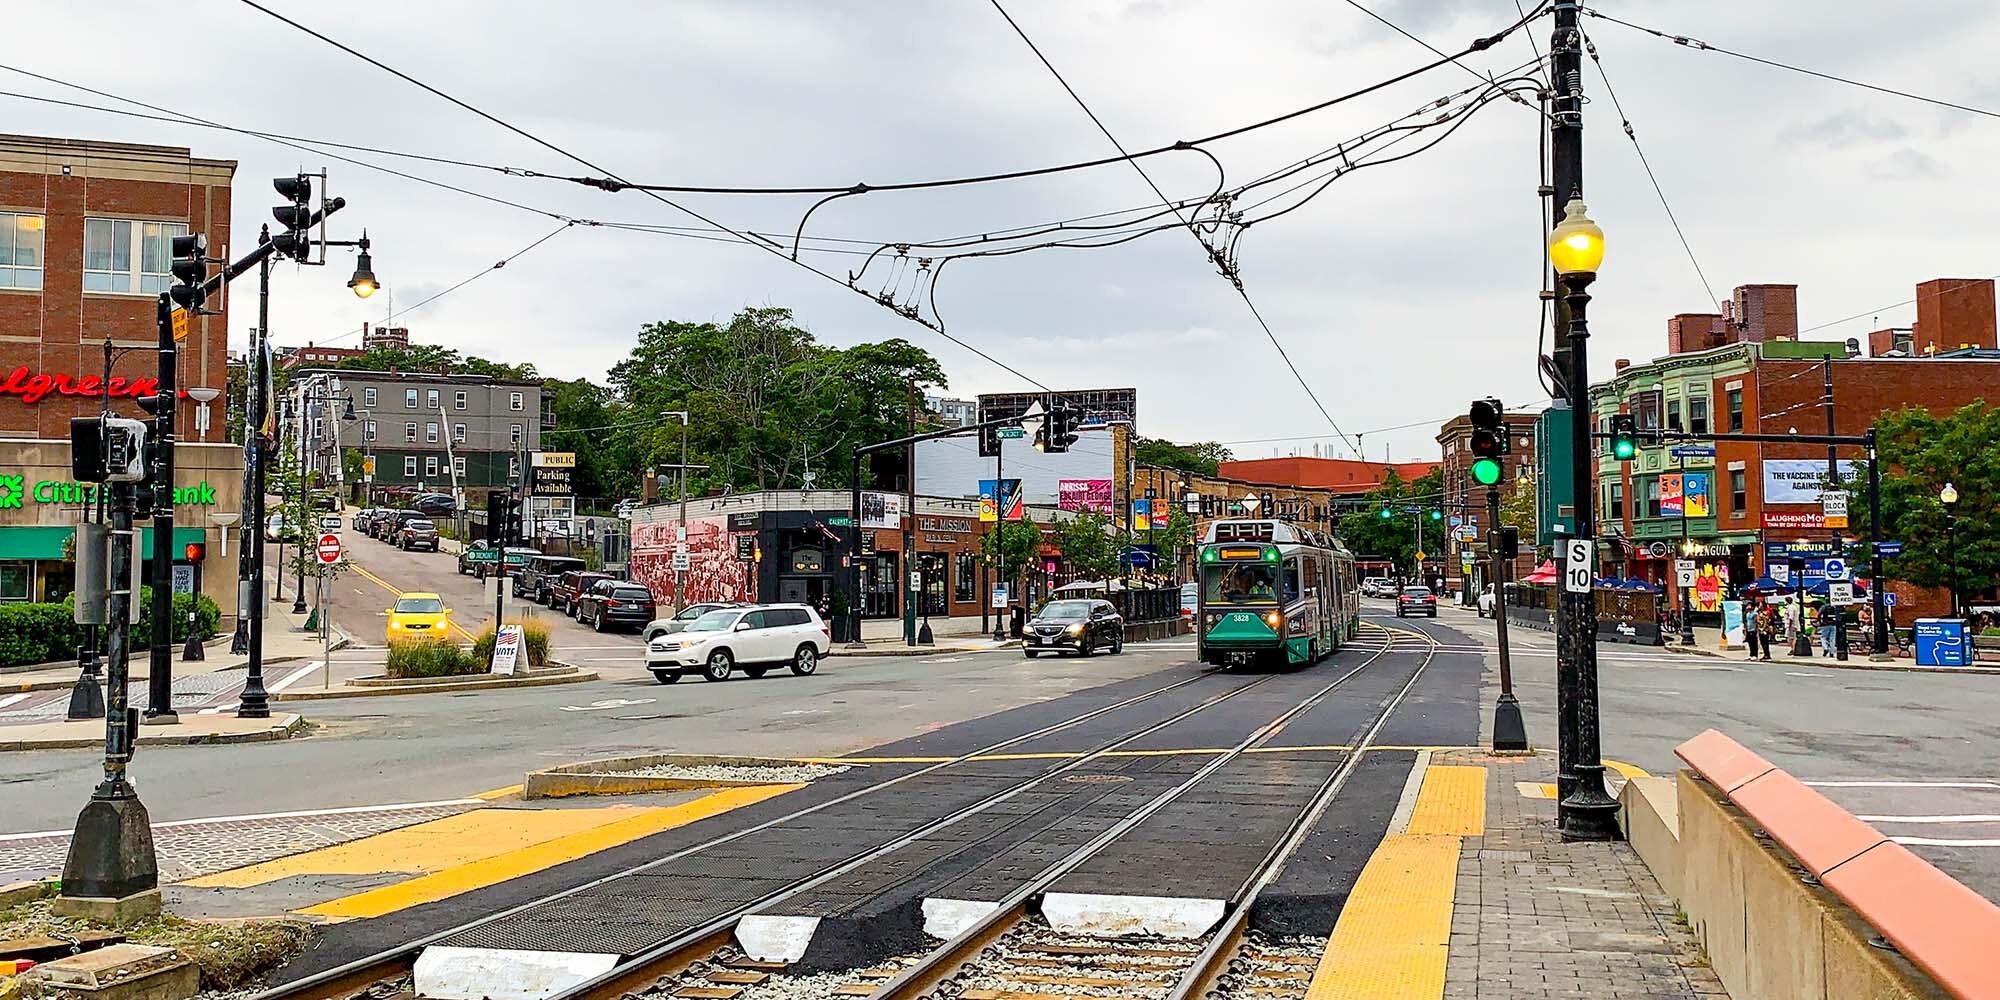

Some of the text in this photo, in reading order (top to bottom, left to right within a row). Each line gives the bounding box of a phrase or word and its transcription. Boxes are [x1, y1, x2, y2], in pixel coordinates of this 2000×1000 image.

[0, 366, 188, 403] lgreen
[545, 456, 574, 464] PUBLIC
[537, 470, 570, 482] Parking
[1773, 472, 1786, 480] THE
[1787, 472, 1815, 480] VACCINE
[534, 482, 572, 493] Available
[1792, 482, 1822, 490] AGAINST
[1663, 502, 1682, 510] LIVE
[918, 517, 972, 532] THE MISSION
[1695, 544, 1731, 557] PENGUIN
[1785, 543, 1825, 552] PENGUIN
[1572, 544, 1586, 563] S
[1568, 568, 1589, 587] 10
[1682, 573, 1691, 583] 9
[1233, 614, 1250, 623] 3828
